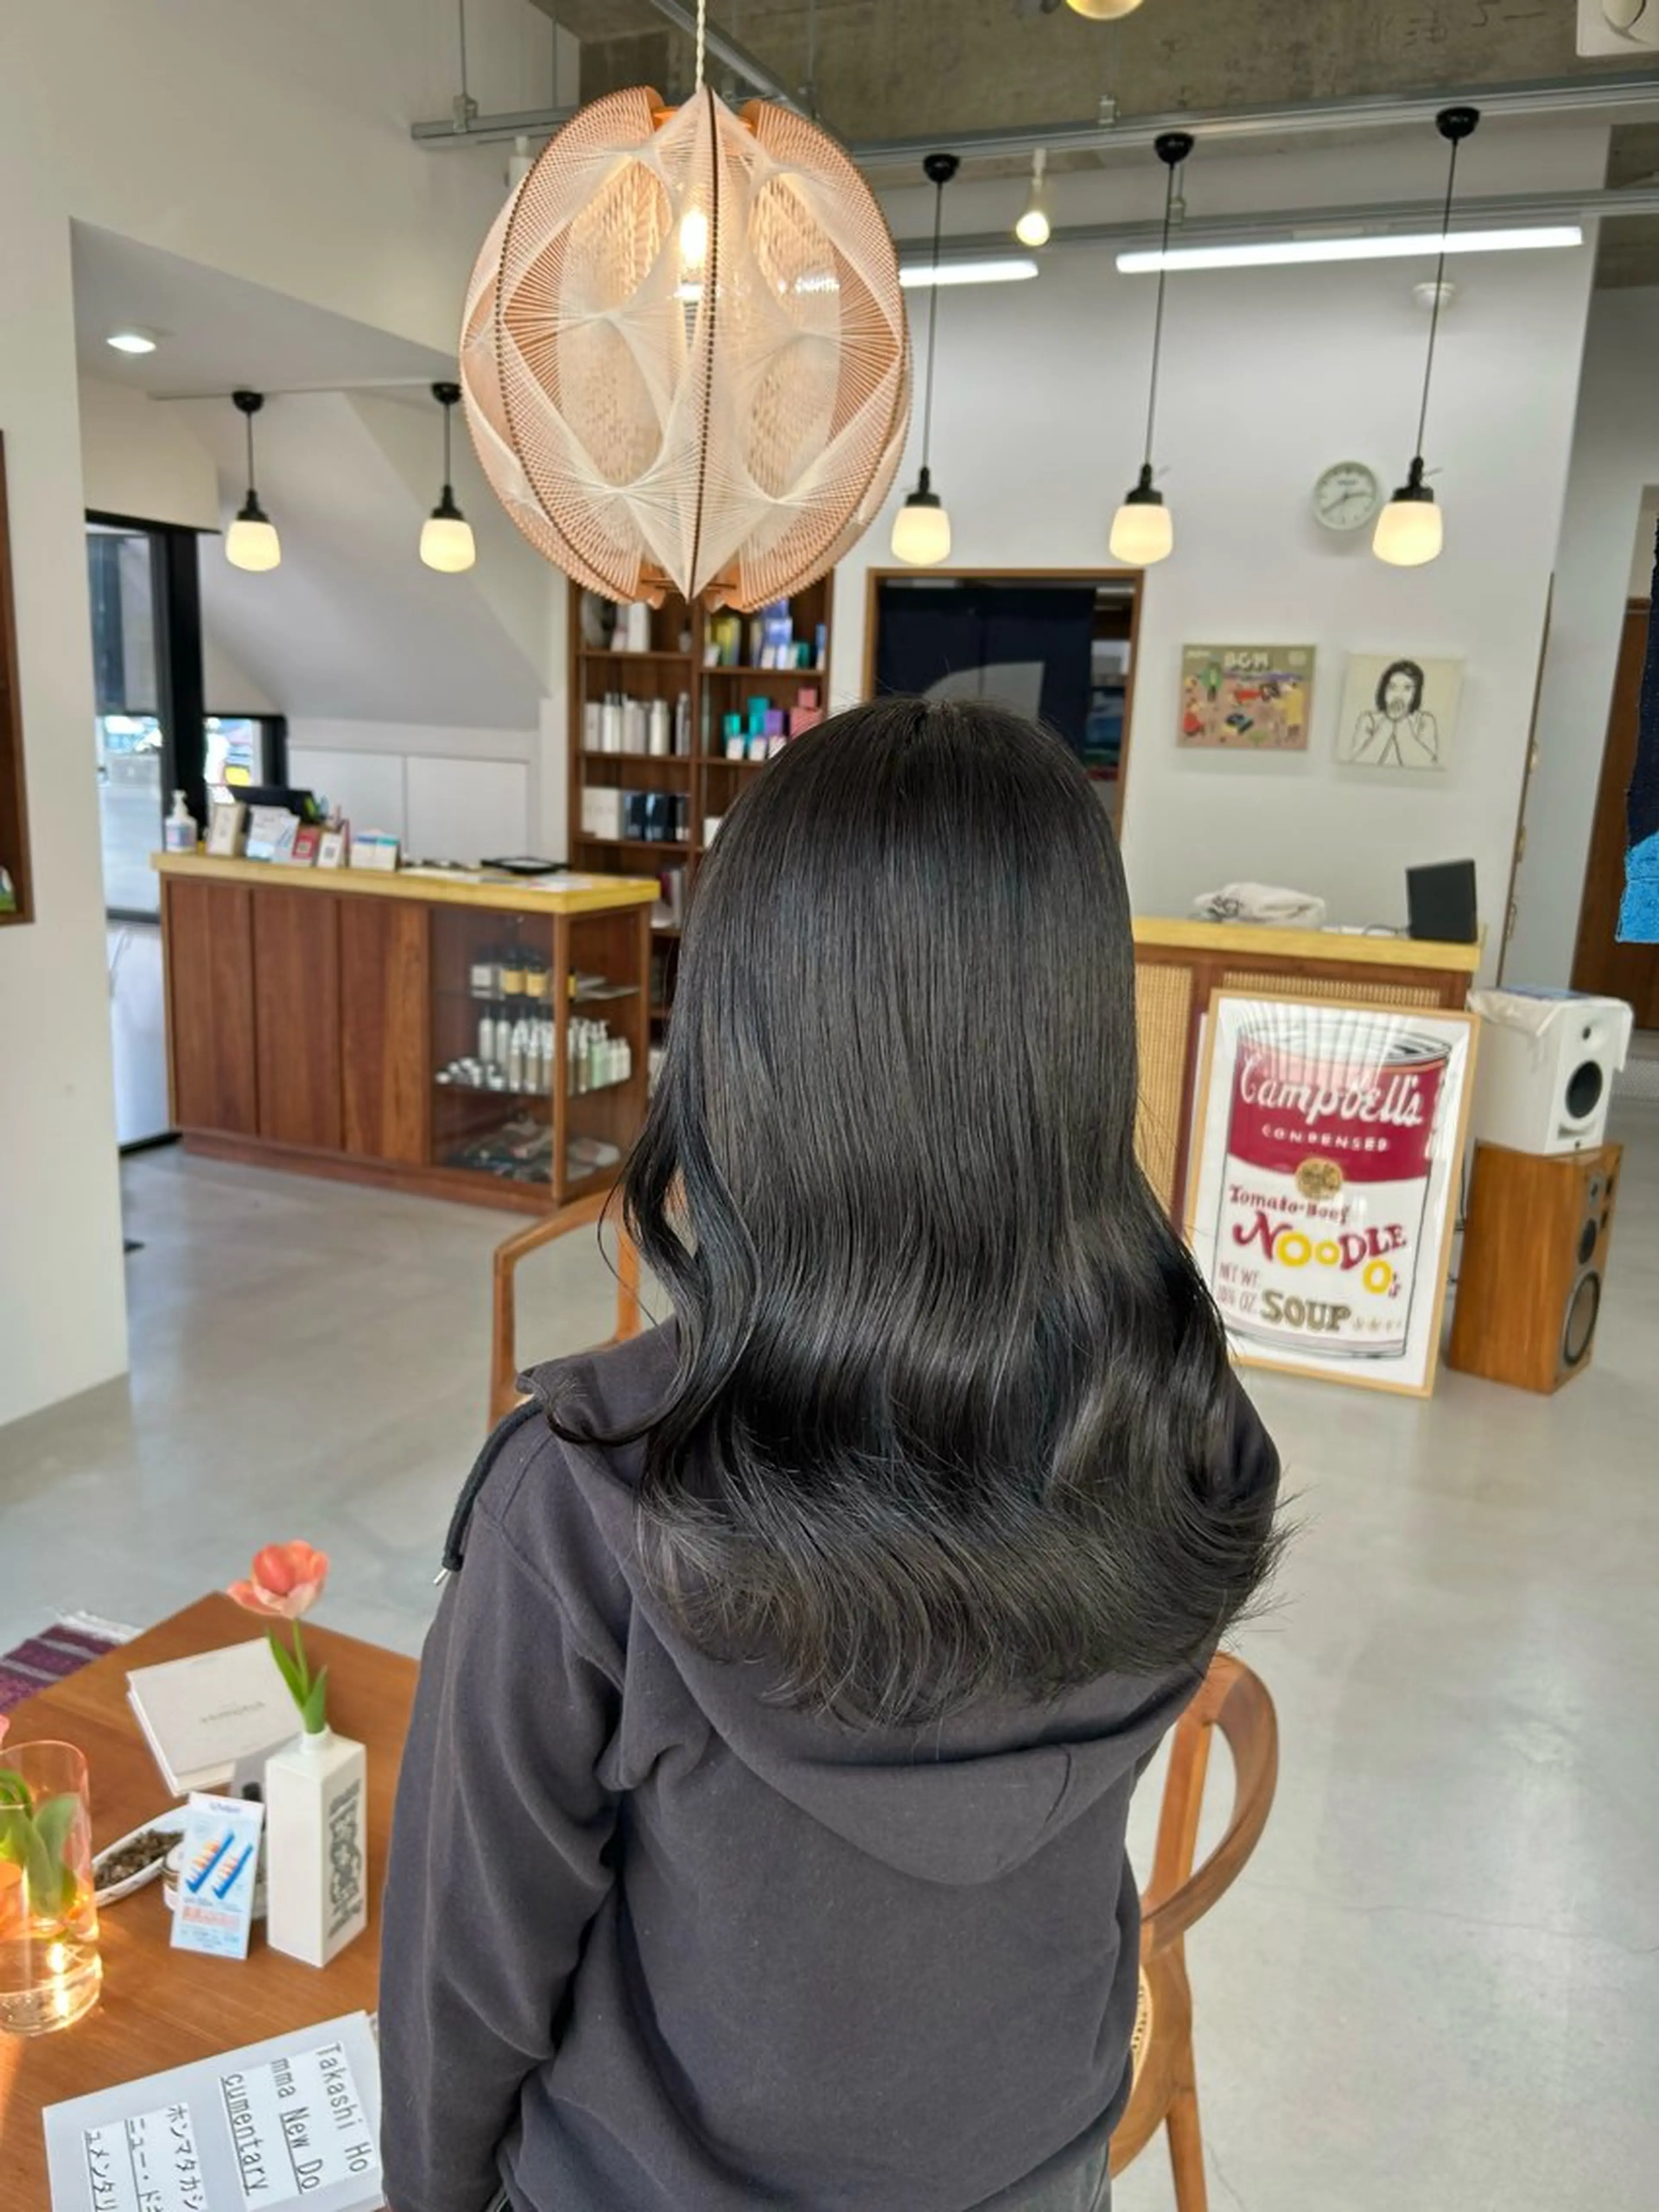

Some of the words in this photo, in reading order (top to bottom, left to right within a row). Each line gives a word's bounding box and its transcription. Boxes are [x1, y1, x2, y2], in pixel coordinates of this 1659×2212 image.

[1240, 1052, 1423, 1127] Campbell's
[1261, 1123, 1390, 1152] CONDENSED
[1260, 1289, 1352, 1331] SOUP
[270, 2057, 296, 2098] mma
[280, 2106, 310, 2148] New
[316, 2042, 363, 2130] Takashi
[344, 2142, 372, 2172] Ho
[224, 2073, 269, 2190] cumentary
[166, 2104, 203, 2210] ホンマタカシ
[296, 2158, 323, 2190] Do
